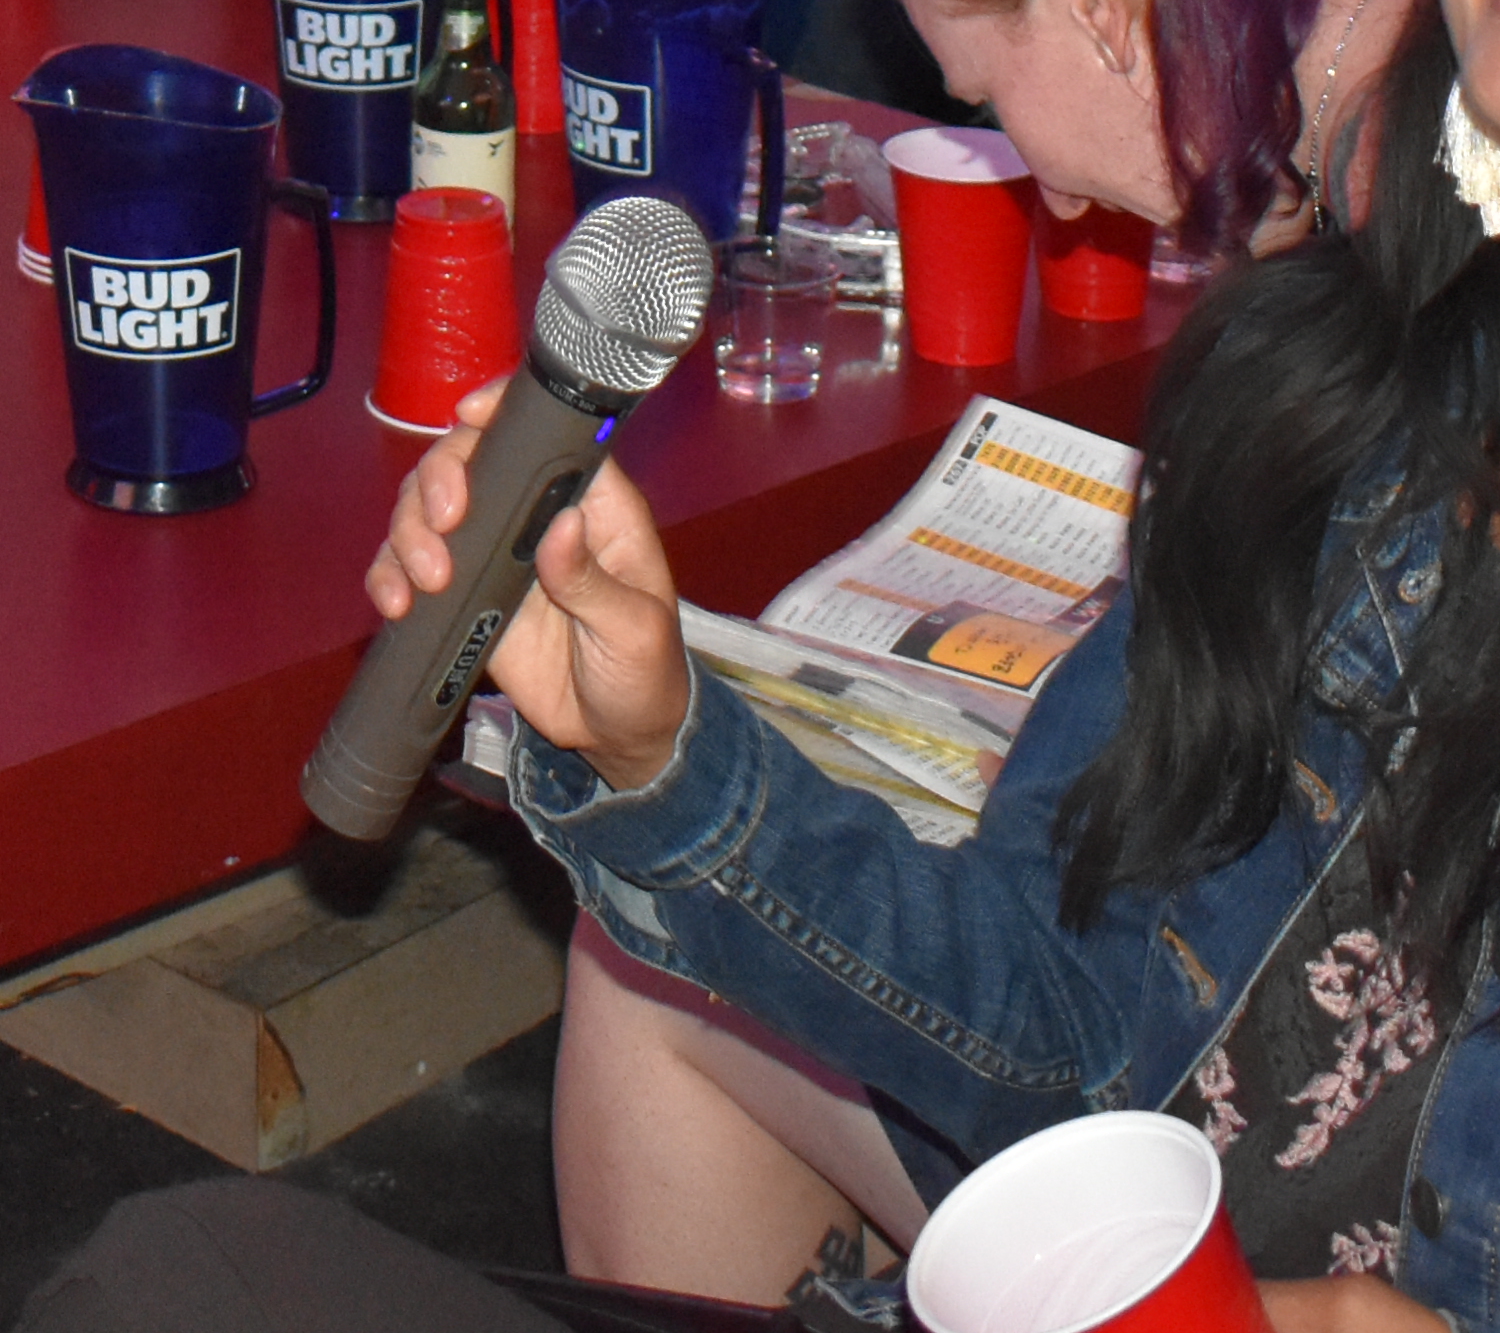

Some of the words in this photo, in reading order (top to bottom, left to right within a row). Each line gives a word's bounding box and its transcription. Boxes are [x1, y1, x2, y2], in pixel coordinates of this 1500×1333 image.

[295, 7, 396, 48] BUD
[285, 37, 414, 81] LIGHT
[562, 74, 619, 125] UD
[566, 112, 641, 164] GHT
[90, 265, 211, 310] BUD
[77, 299, 230, 349] LIGHT
